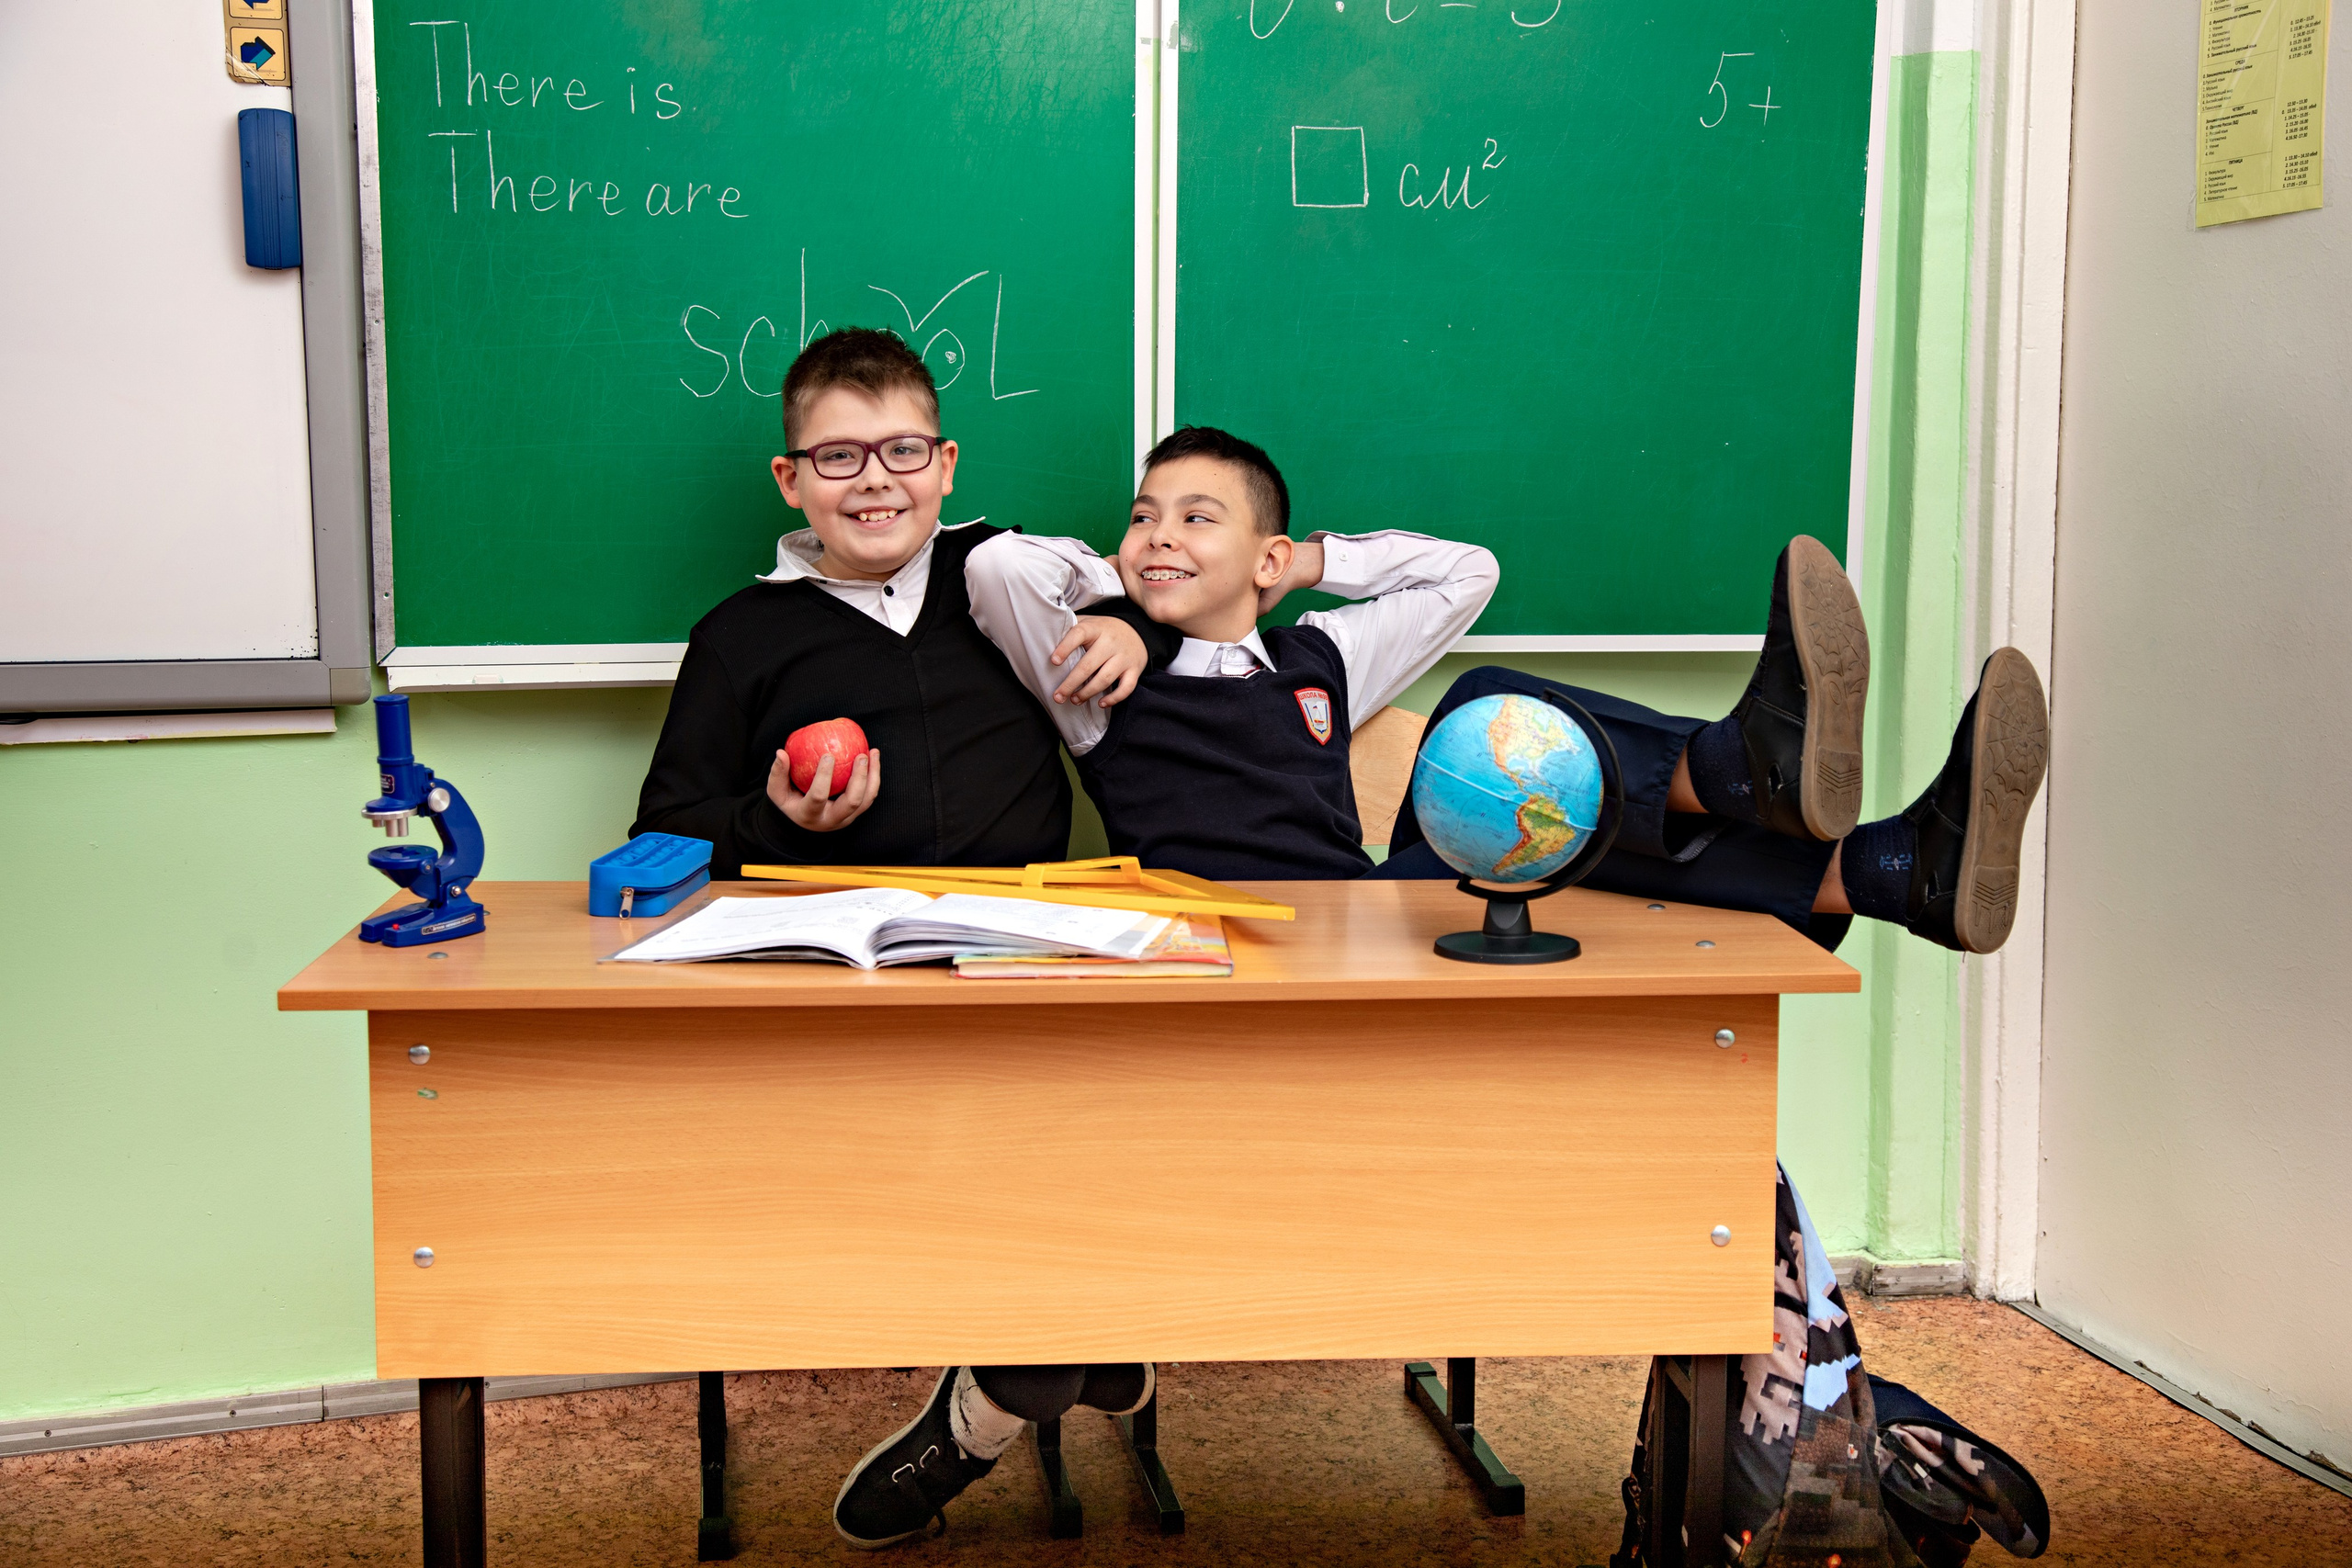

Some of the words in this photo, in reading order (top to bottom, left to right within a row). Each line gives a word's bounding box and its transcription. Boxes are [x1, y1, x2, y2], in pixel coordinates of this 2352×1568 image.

[410, 21, 604, 110] There
[626, 67, 682, 119] is
[428, 129, 627, 217] There
[646, 181, 749, 219] are
[1298, 692, 1317, 700] ШКОЛА
